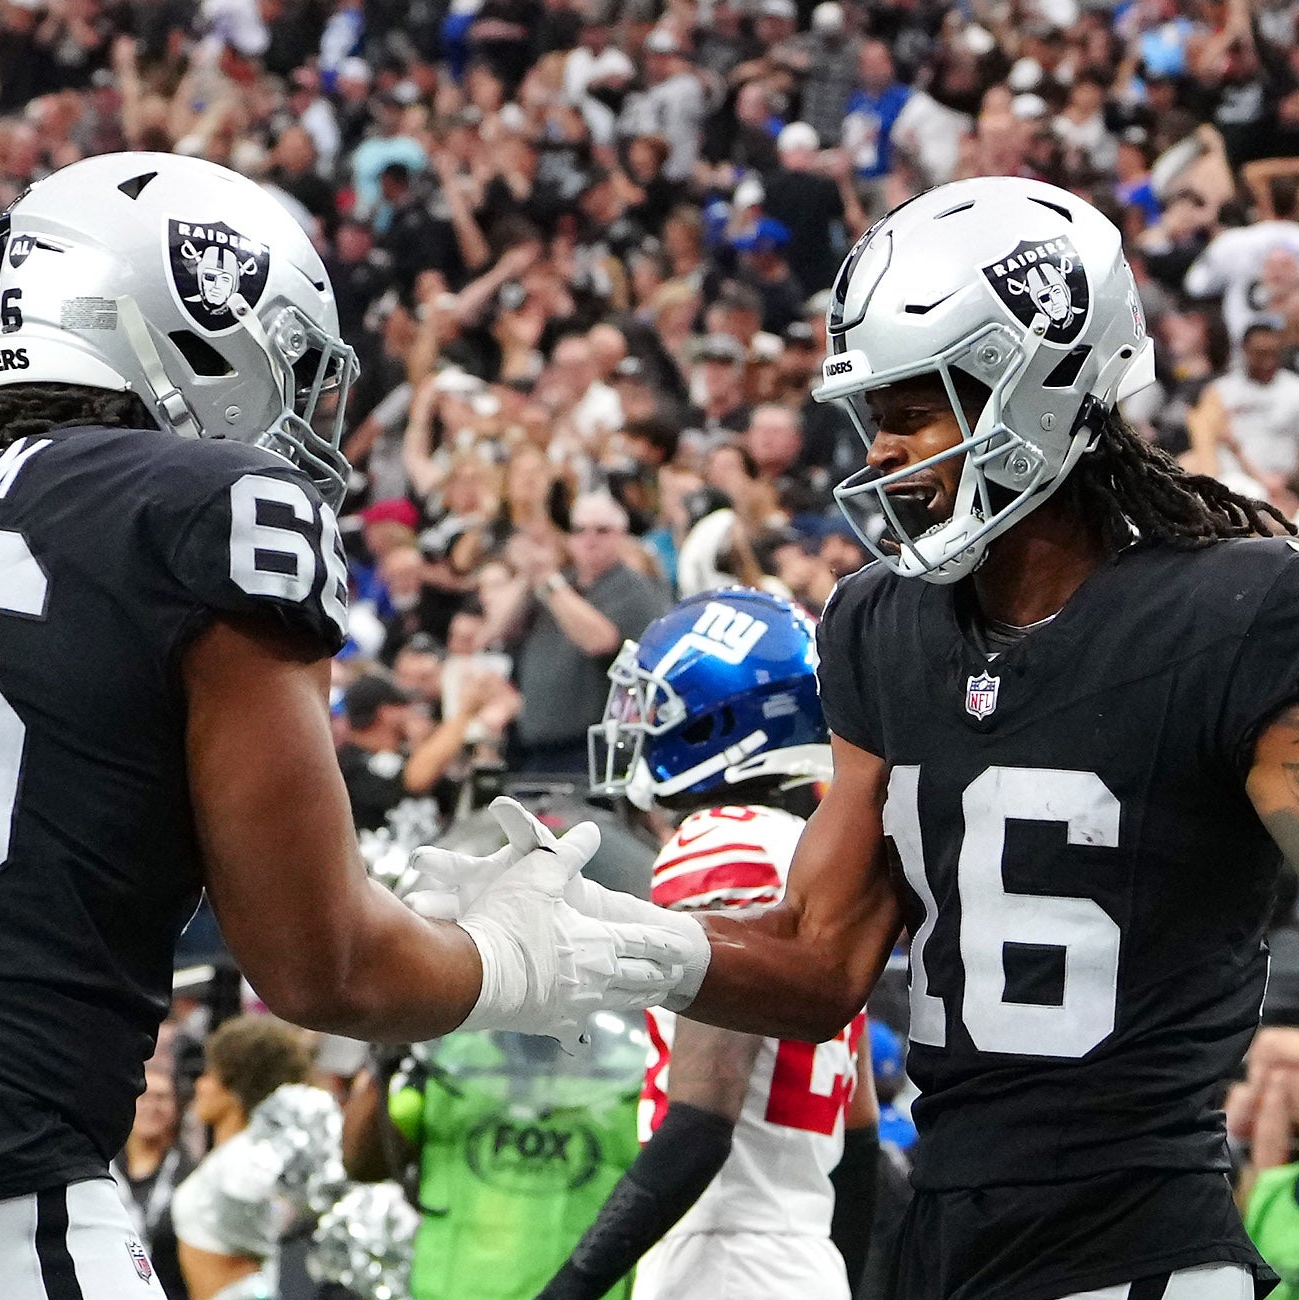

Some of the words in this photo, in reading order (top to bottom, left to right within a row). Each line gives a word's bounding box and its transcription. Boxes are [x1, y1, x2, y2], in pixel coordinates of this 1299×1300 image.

[10, 240, 30, 256] AL
[993, 238, 1066, 278] RAIDERS
[230, 474, 349, 637] 66
[971, 693, 991, 710] NFL
[882, 765, 1121, 1058] 16
[495, 1124, 572, 1160] FOX
